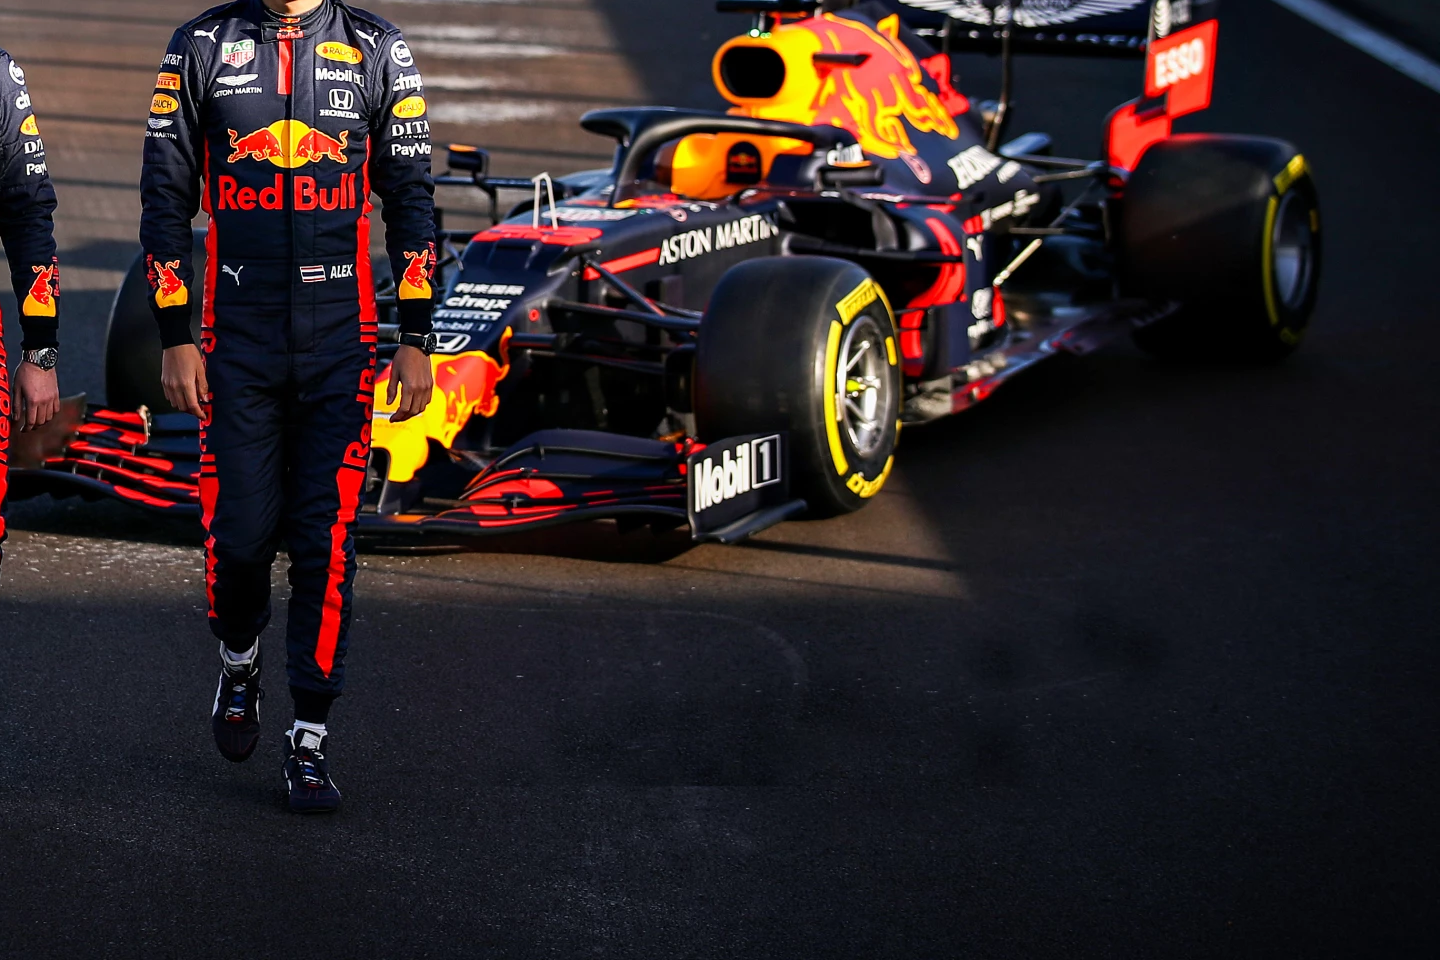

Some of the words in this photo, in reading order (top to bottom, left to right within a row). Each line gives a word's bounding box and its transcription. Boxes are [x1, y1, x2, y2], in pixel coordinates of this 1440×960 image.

[224, 41, 252, 54] TAG
[329, 46, 358, 60] RAUCH
[163, 53, 183, 66] AT&T
[224, 51, 254, 67] HEUER
[315, 67, 353, 82] Mobil
[213, 88, 233, 98] ASTON
[235, 86, 262, 95] MARTIN
[153, 99, 173, 109] RAUCH
[319, 109, 360, 119] HONDA
[152, 131, 178, 140] MARTIN
[391, 120, 430, 137] DITA
[218, 173, 283, 210] Red
[293, 173, 356, 211] Bull
[659, 226, 712, 266] ASTON
[715, 210, 779, 251] MARTIN
[330, 263, 353, 279] ALEX
[433, 321, 474, 332] Mobil
[343, 393, 374, 468] Red
[694, 442, 750, 513] Mobil
